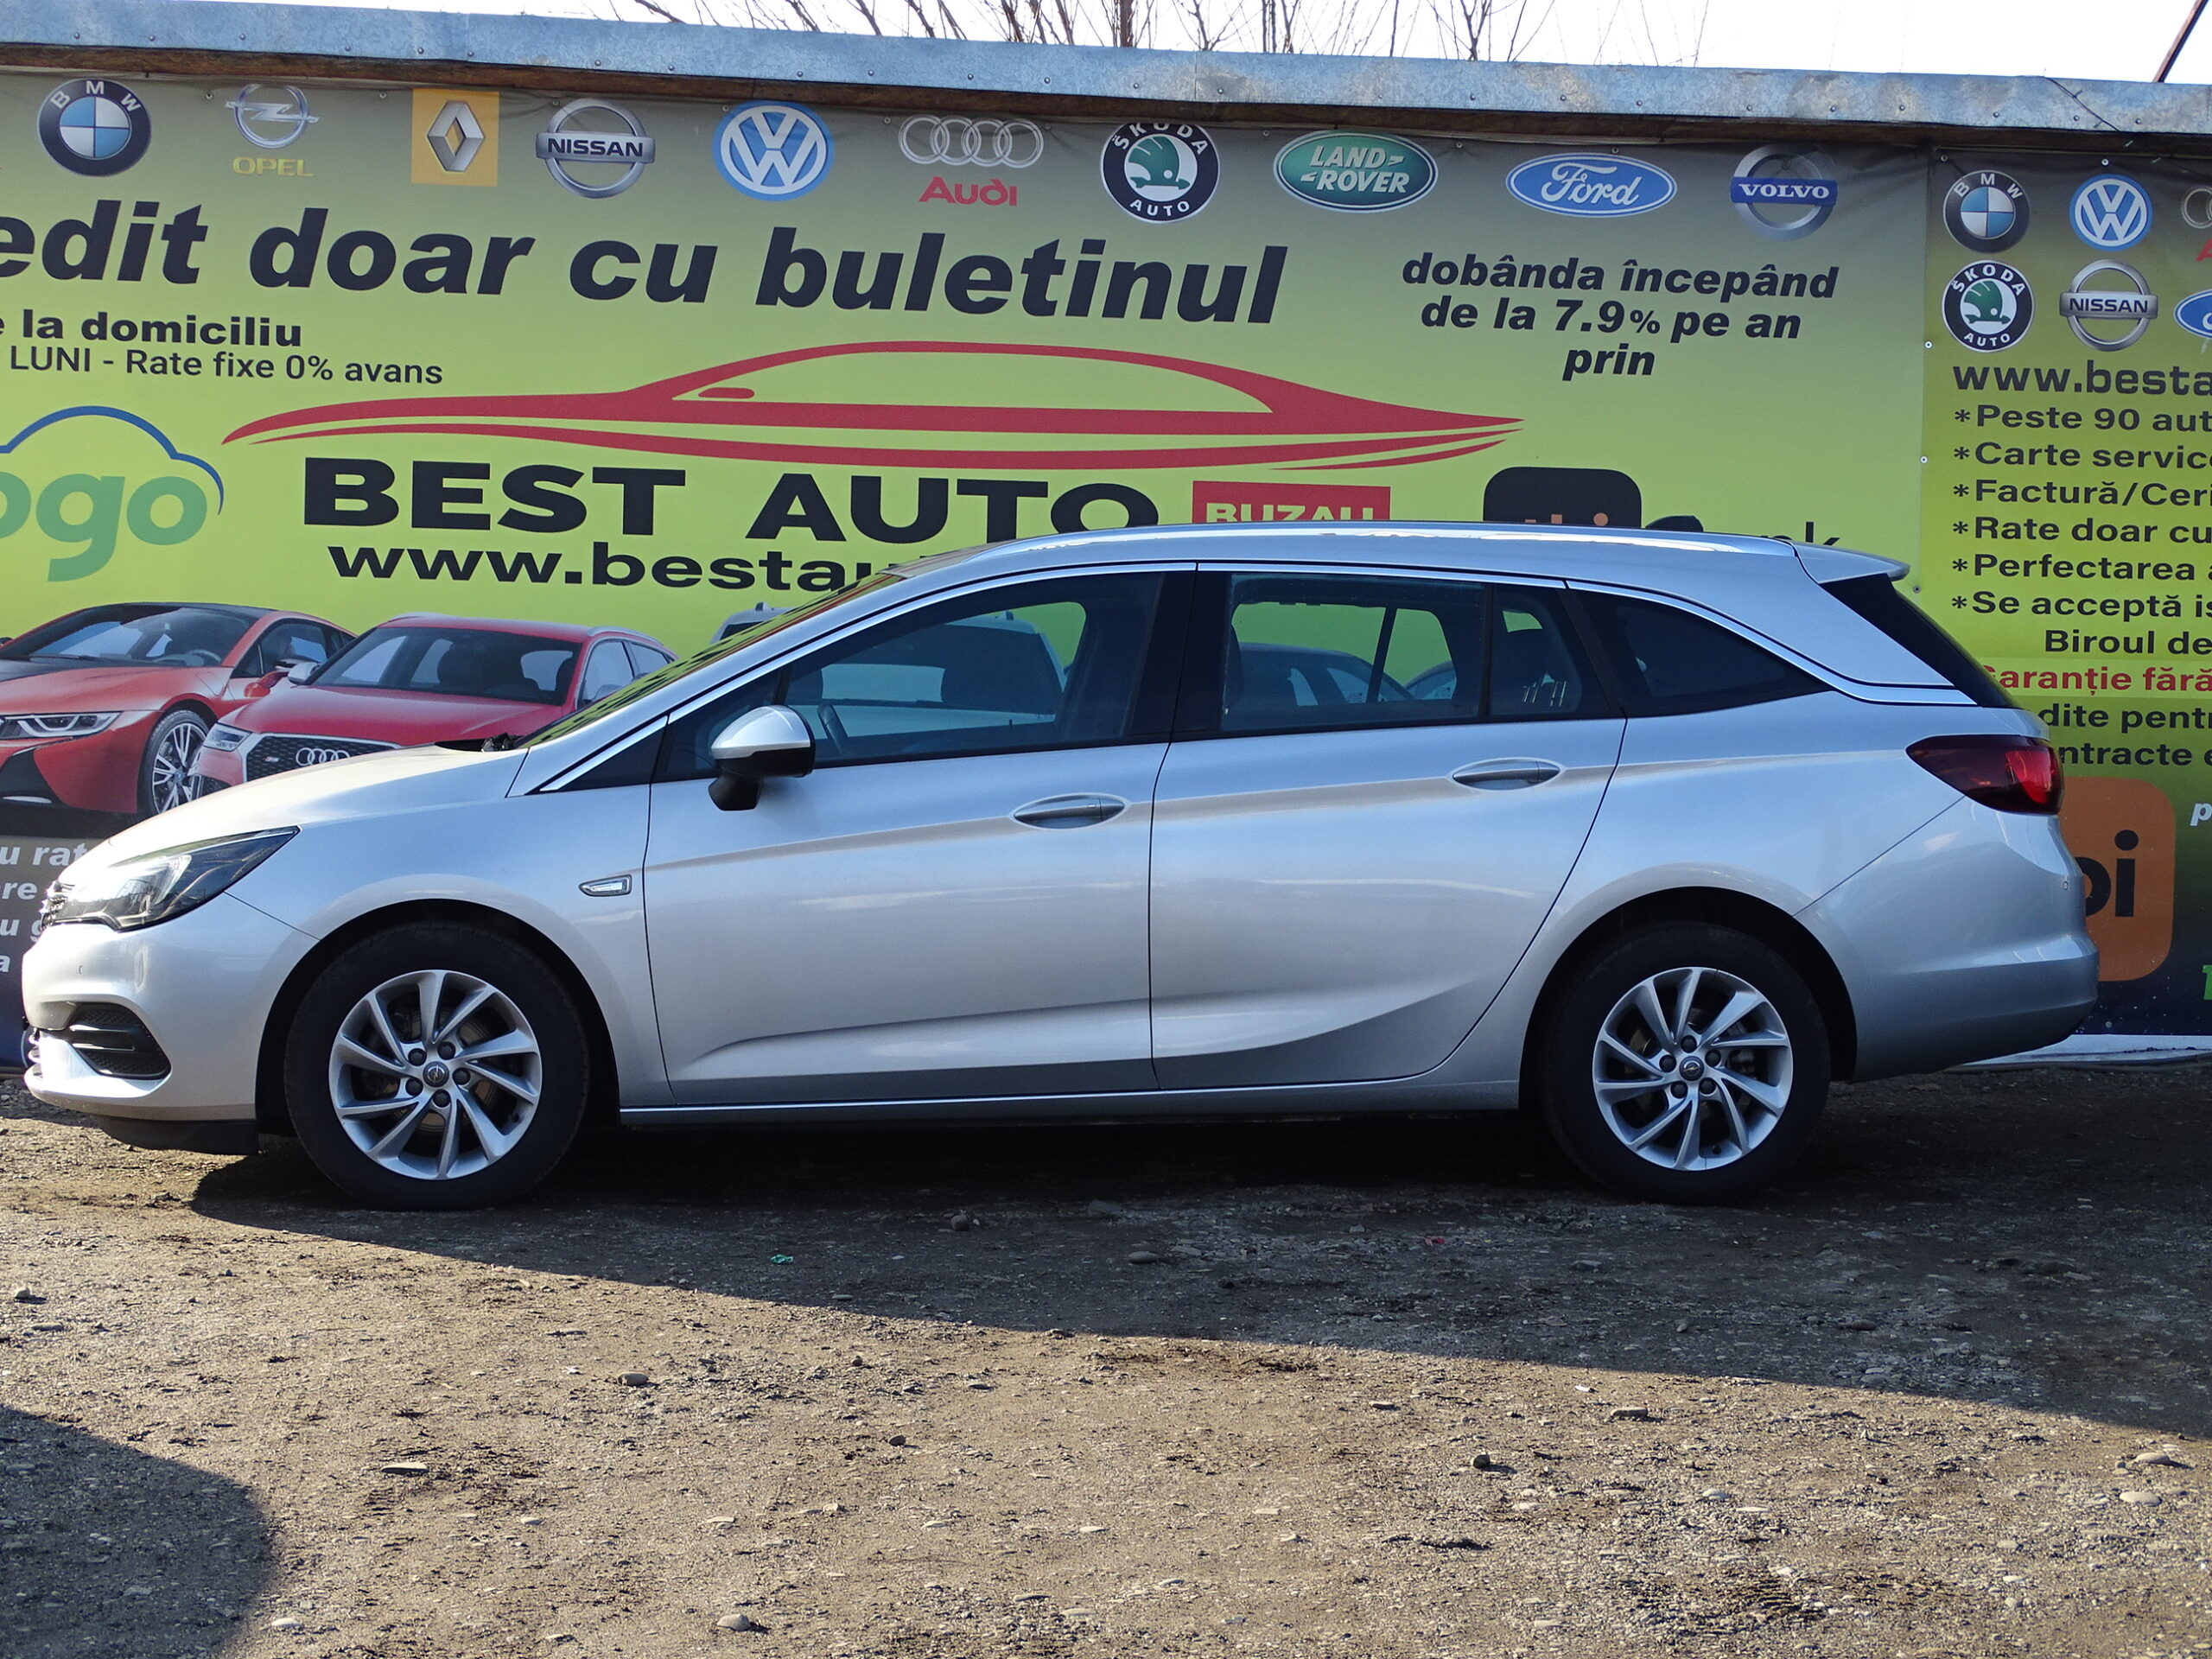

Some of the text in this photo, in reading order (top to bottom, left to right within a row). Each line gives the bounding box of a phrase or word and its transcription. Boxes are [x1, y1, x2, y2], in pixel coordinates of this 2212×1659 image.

[50, 80, 141, 112] BMW
[548, 137, 643, 158] NISSAN
[232, 156, 314, 177] OPEL
[918, 175, 1018, 207] Audi
[1317, 169, 1410, 193] ROVER
[1541, 162, 1643, 207] Ford
[1738, 183, 1829, 199] VOLVO
[1954, 173, 2023, 200] BMW
[1130, 199, 1190, 217] AUTO
[250, 207, 536, 295] doar
[569, 239, 718, 303] cu
[755, 226, 1288, 324] buletinul
[1402, 252, 1840, 303] dobânda începând
[2069, 296, 2148, 313] NISSAN
[23, 308, 63, 339] la
[81, 311, 302, 346] domiciliu
[1421, 296, 1478, 327] de
[1494, 297, 1535, 330] la
[1670, 310, 1729, 343] pe
[1745, 314, 1802, 339] an
[1964, 332, 2011, 346] AUTO
[11, 346, 90, 372] LUNI
[126, 349, 202, 376] Rate
[213, 352, 274, 378] fixe
[286, 354, 334, 381] 0%
[345, 360, 442, 385] avans
[1562, 344, 1656, 381] prin
[1953, 359, 2212, 396] www.besta
[2094, 408, 2140, 430] 90
[2092, 445, 2212, 470] servic
[304, 457, 1160, 543] BEST AUTO
[1953, 480, 2212, 506] Factură/Cer
[2071, 518, 2158, 543] doar
[2170, 525, 2212, 544] cu
[2031, 594, 2181, 622] acceptă
[2045, 629, 2212, 655] Biroul de
[2143, 667, 2212, 692] fără
[2121, 708, 2212, 734] pent
[0, 882, 37, 900] re
